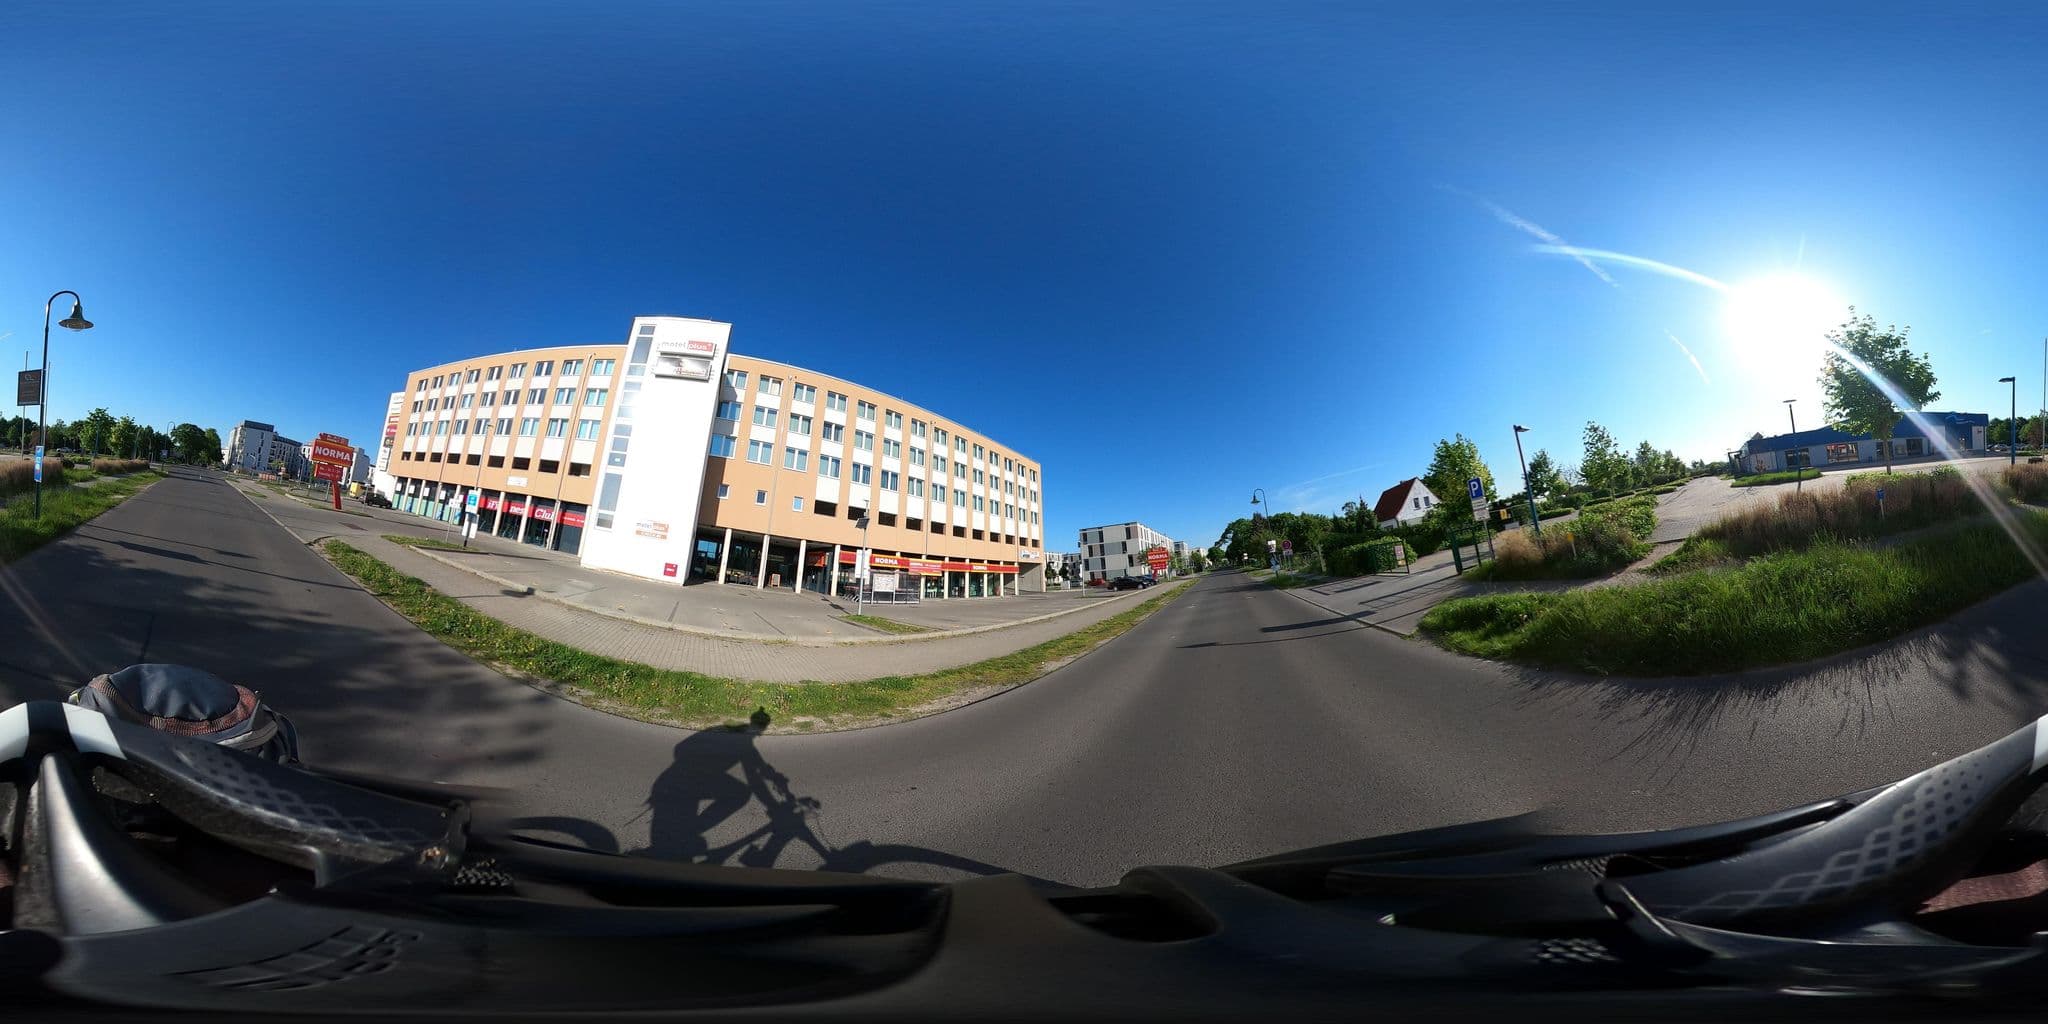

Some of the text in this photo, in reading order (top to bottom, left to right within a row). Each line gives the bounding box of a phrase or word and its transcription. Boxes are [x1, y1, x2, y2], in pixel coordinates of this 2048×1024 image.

[315, 446, 351, 461] NORMA
[1470, 481, 1479, 497] P
[874, 557, 898, 565] NORMA
